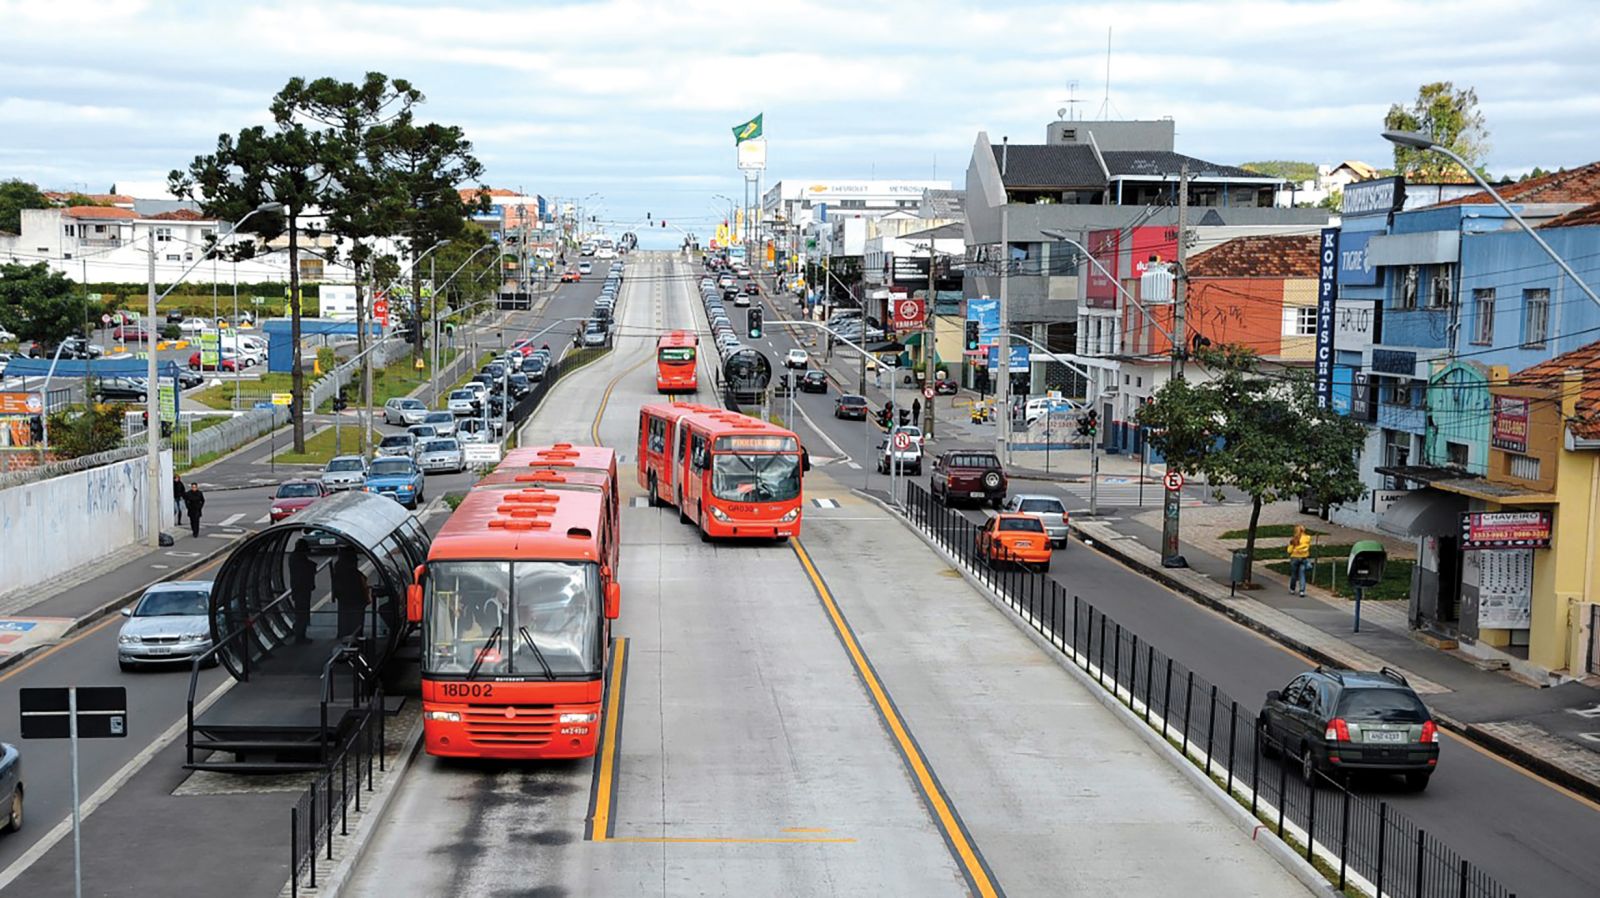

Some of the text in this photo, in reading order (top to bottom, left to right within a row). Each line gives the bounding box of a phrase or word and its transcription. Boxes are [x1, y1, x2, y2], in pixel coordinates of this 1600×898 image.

[1341, 250, 1363, 271] TIGRE
[1317, 233, 1335, 408] KOMPATSCHER
[1482, 512, 1539, 521] CHAVEIRO
[442, 683, 493, 697] 18D02
